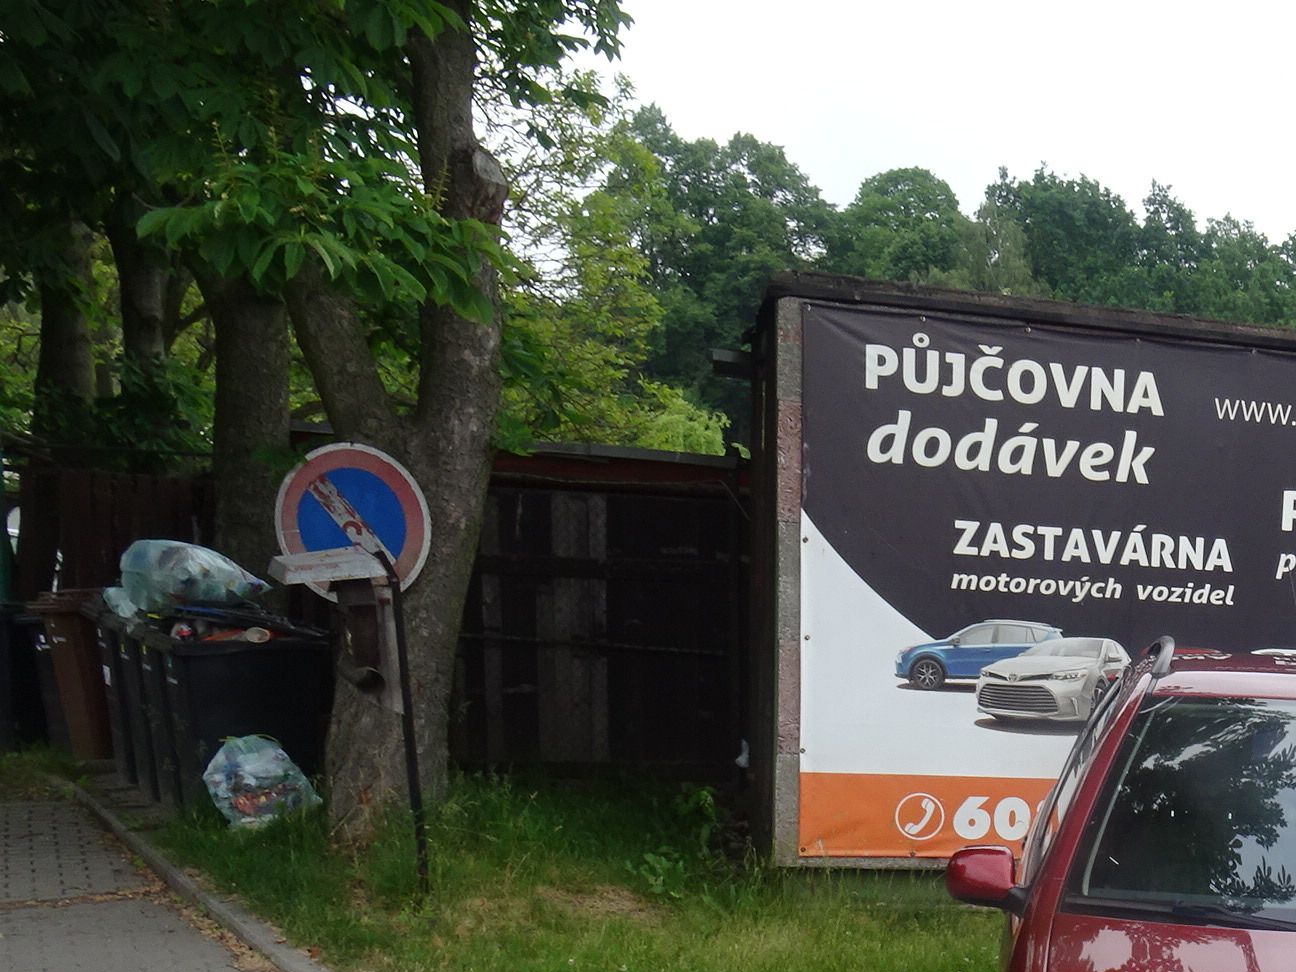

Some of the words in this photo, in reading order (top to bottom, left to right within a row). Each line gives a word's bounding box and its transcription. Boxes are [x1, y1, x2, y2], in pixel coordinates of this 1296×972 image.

[864, 332, 1165, 417] PŮJČOVNA
[866, 409, 1156, 485] dodávek
[952, 519, 1234, 573] ZASTAVÁRNA
[950, 571, 1122, 602] motorových
[1136, 582, 1235, 606] vozidel
[953, 796, 1046, 841] 60
